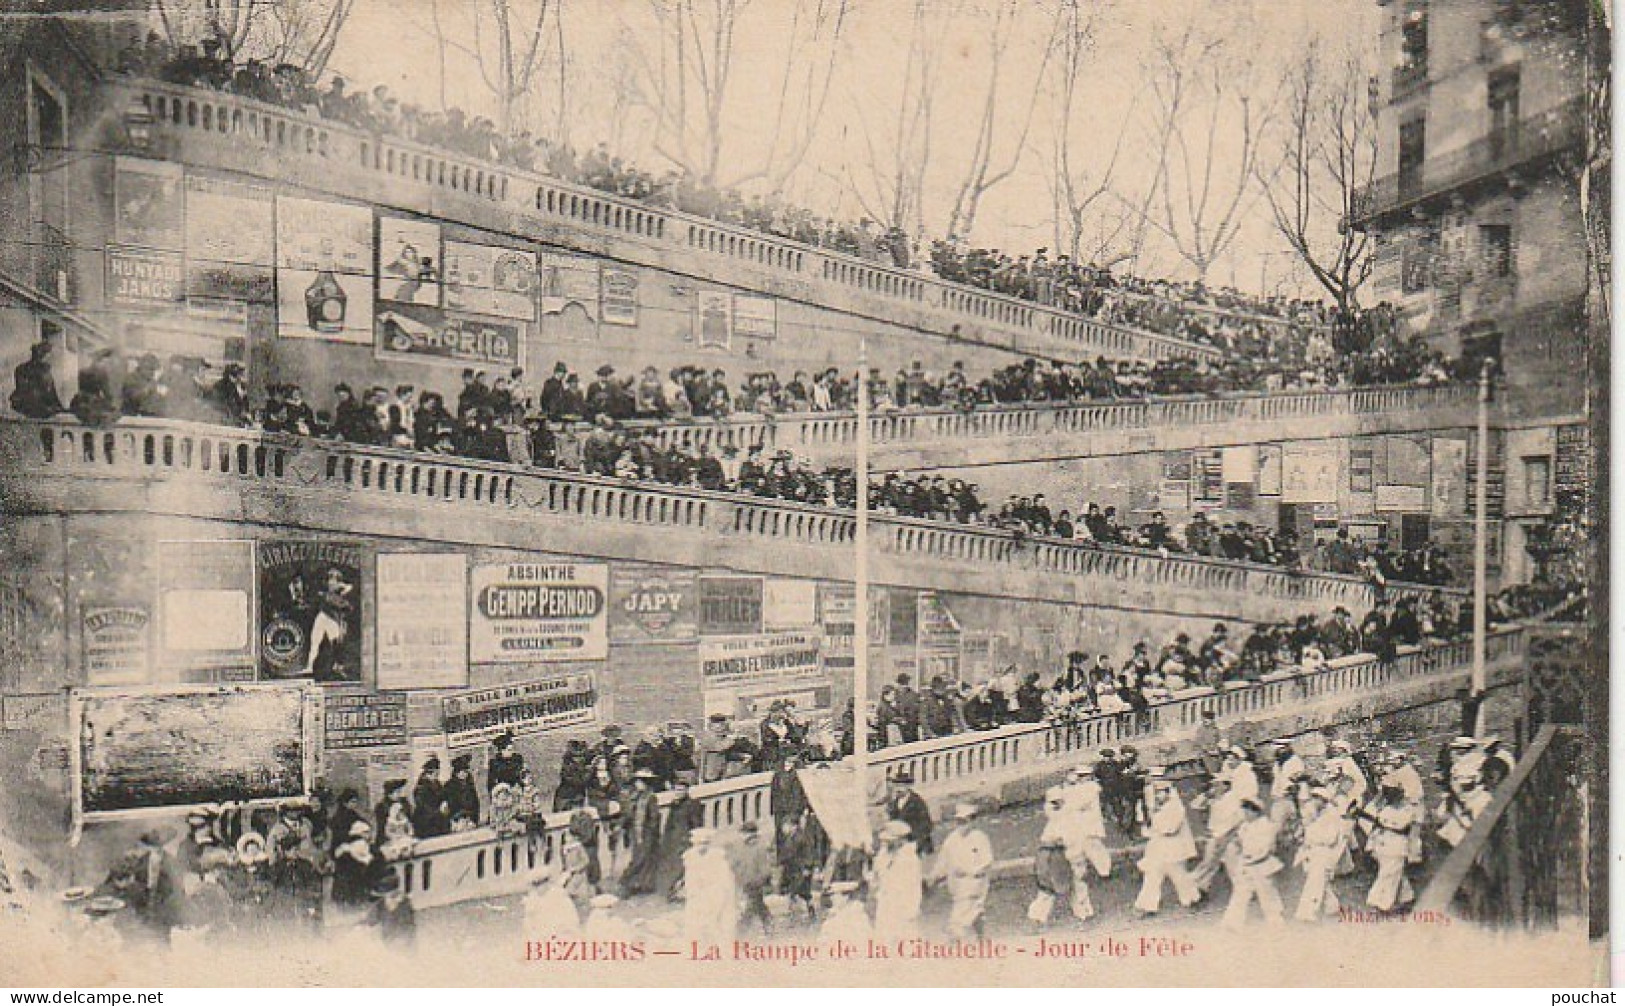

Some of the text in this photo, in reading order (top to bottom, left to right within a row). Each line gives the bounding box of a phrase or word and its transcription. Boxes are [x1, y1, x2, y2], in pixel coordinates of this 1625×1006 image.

[508, 565, 575, 580] ABSINTHE
[539, 586, 596, 616] PERNOD
[624, 592, 682, 611] JAPY
